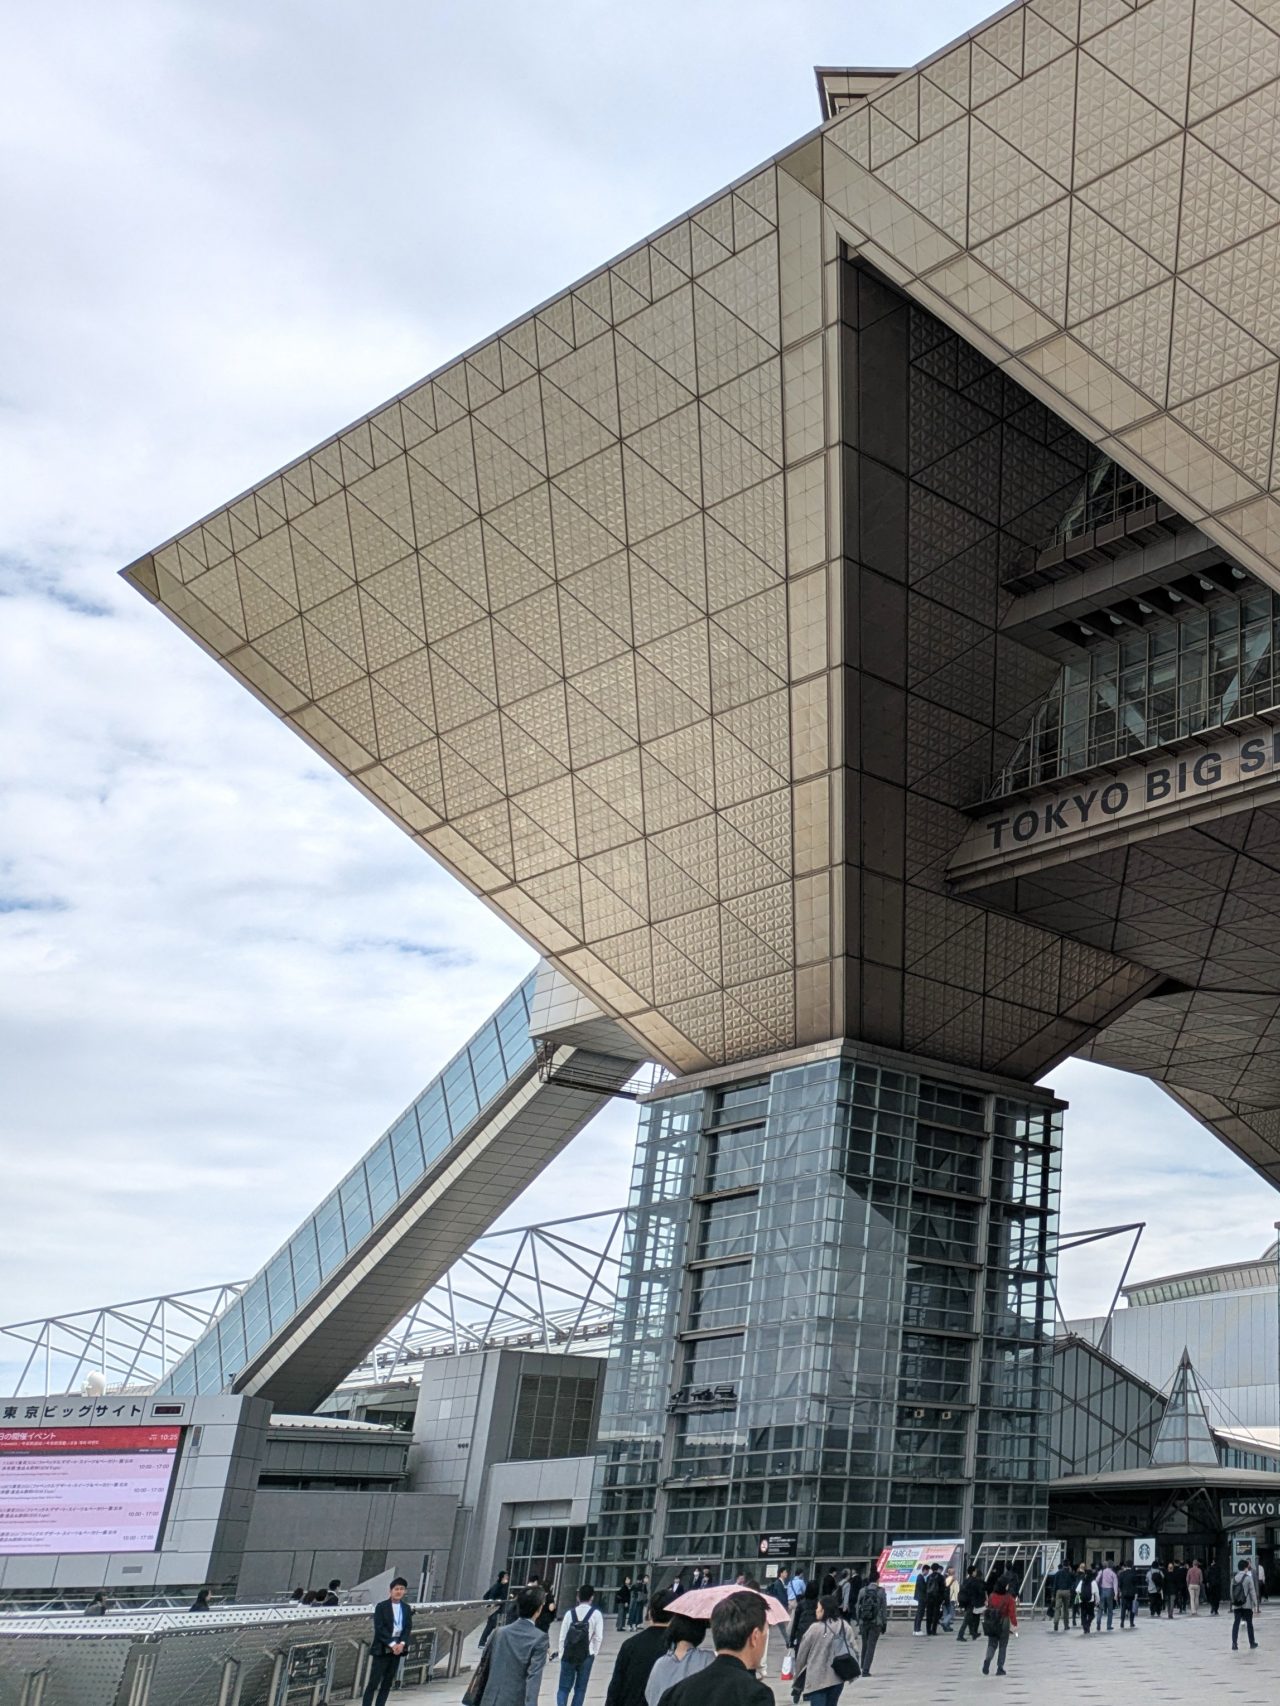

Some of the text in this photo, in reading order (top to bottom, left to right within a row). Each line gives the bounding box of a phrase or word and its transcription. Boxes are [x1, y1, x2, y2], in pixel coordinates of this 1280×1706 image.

[987, 782, 1129, 850] TOKYO
[1146, 752, 1222, 803] BIG
[3, 1405, 141, 1419] 東京ビッグサイト
[1229, 1502, 1275, 1515] TOKYO
